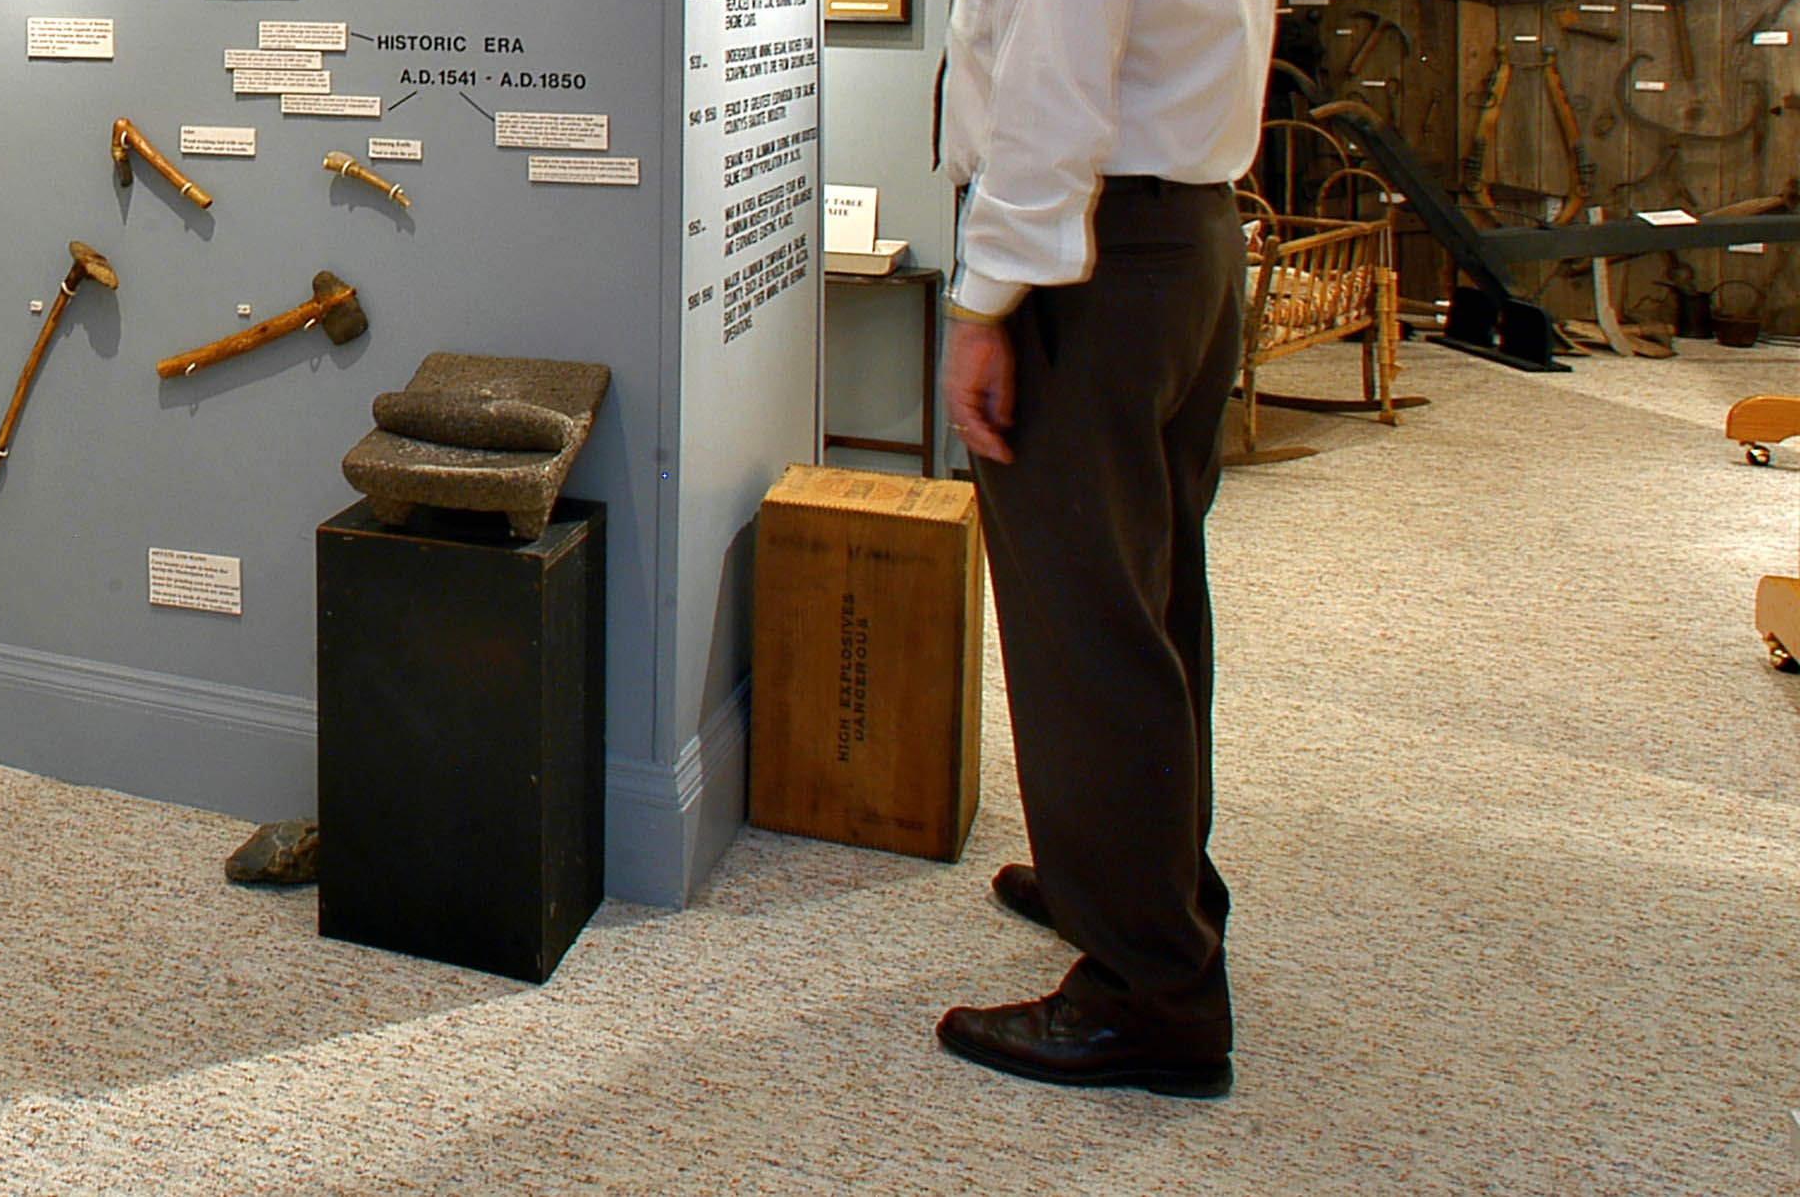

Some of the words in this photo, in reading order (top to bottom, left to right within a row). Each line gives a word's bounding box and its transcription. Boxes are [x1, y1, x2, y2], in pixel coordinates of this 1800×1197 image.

[378, 35, 466, 52] HISTORIC
[484, 37, 524, 53] ERA
[839, 594, 855, 708] EXPLOSIVES
[854, 618, 870, 742] DANGEROUS
[837, 718, 850, 763] HIGH
